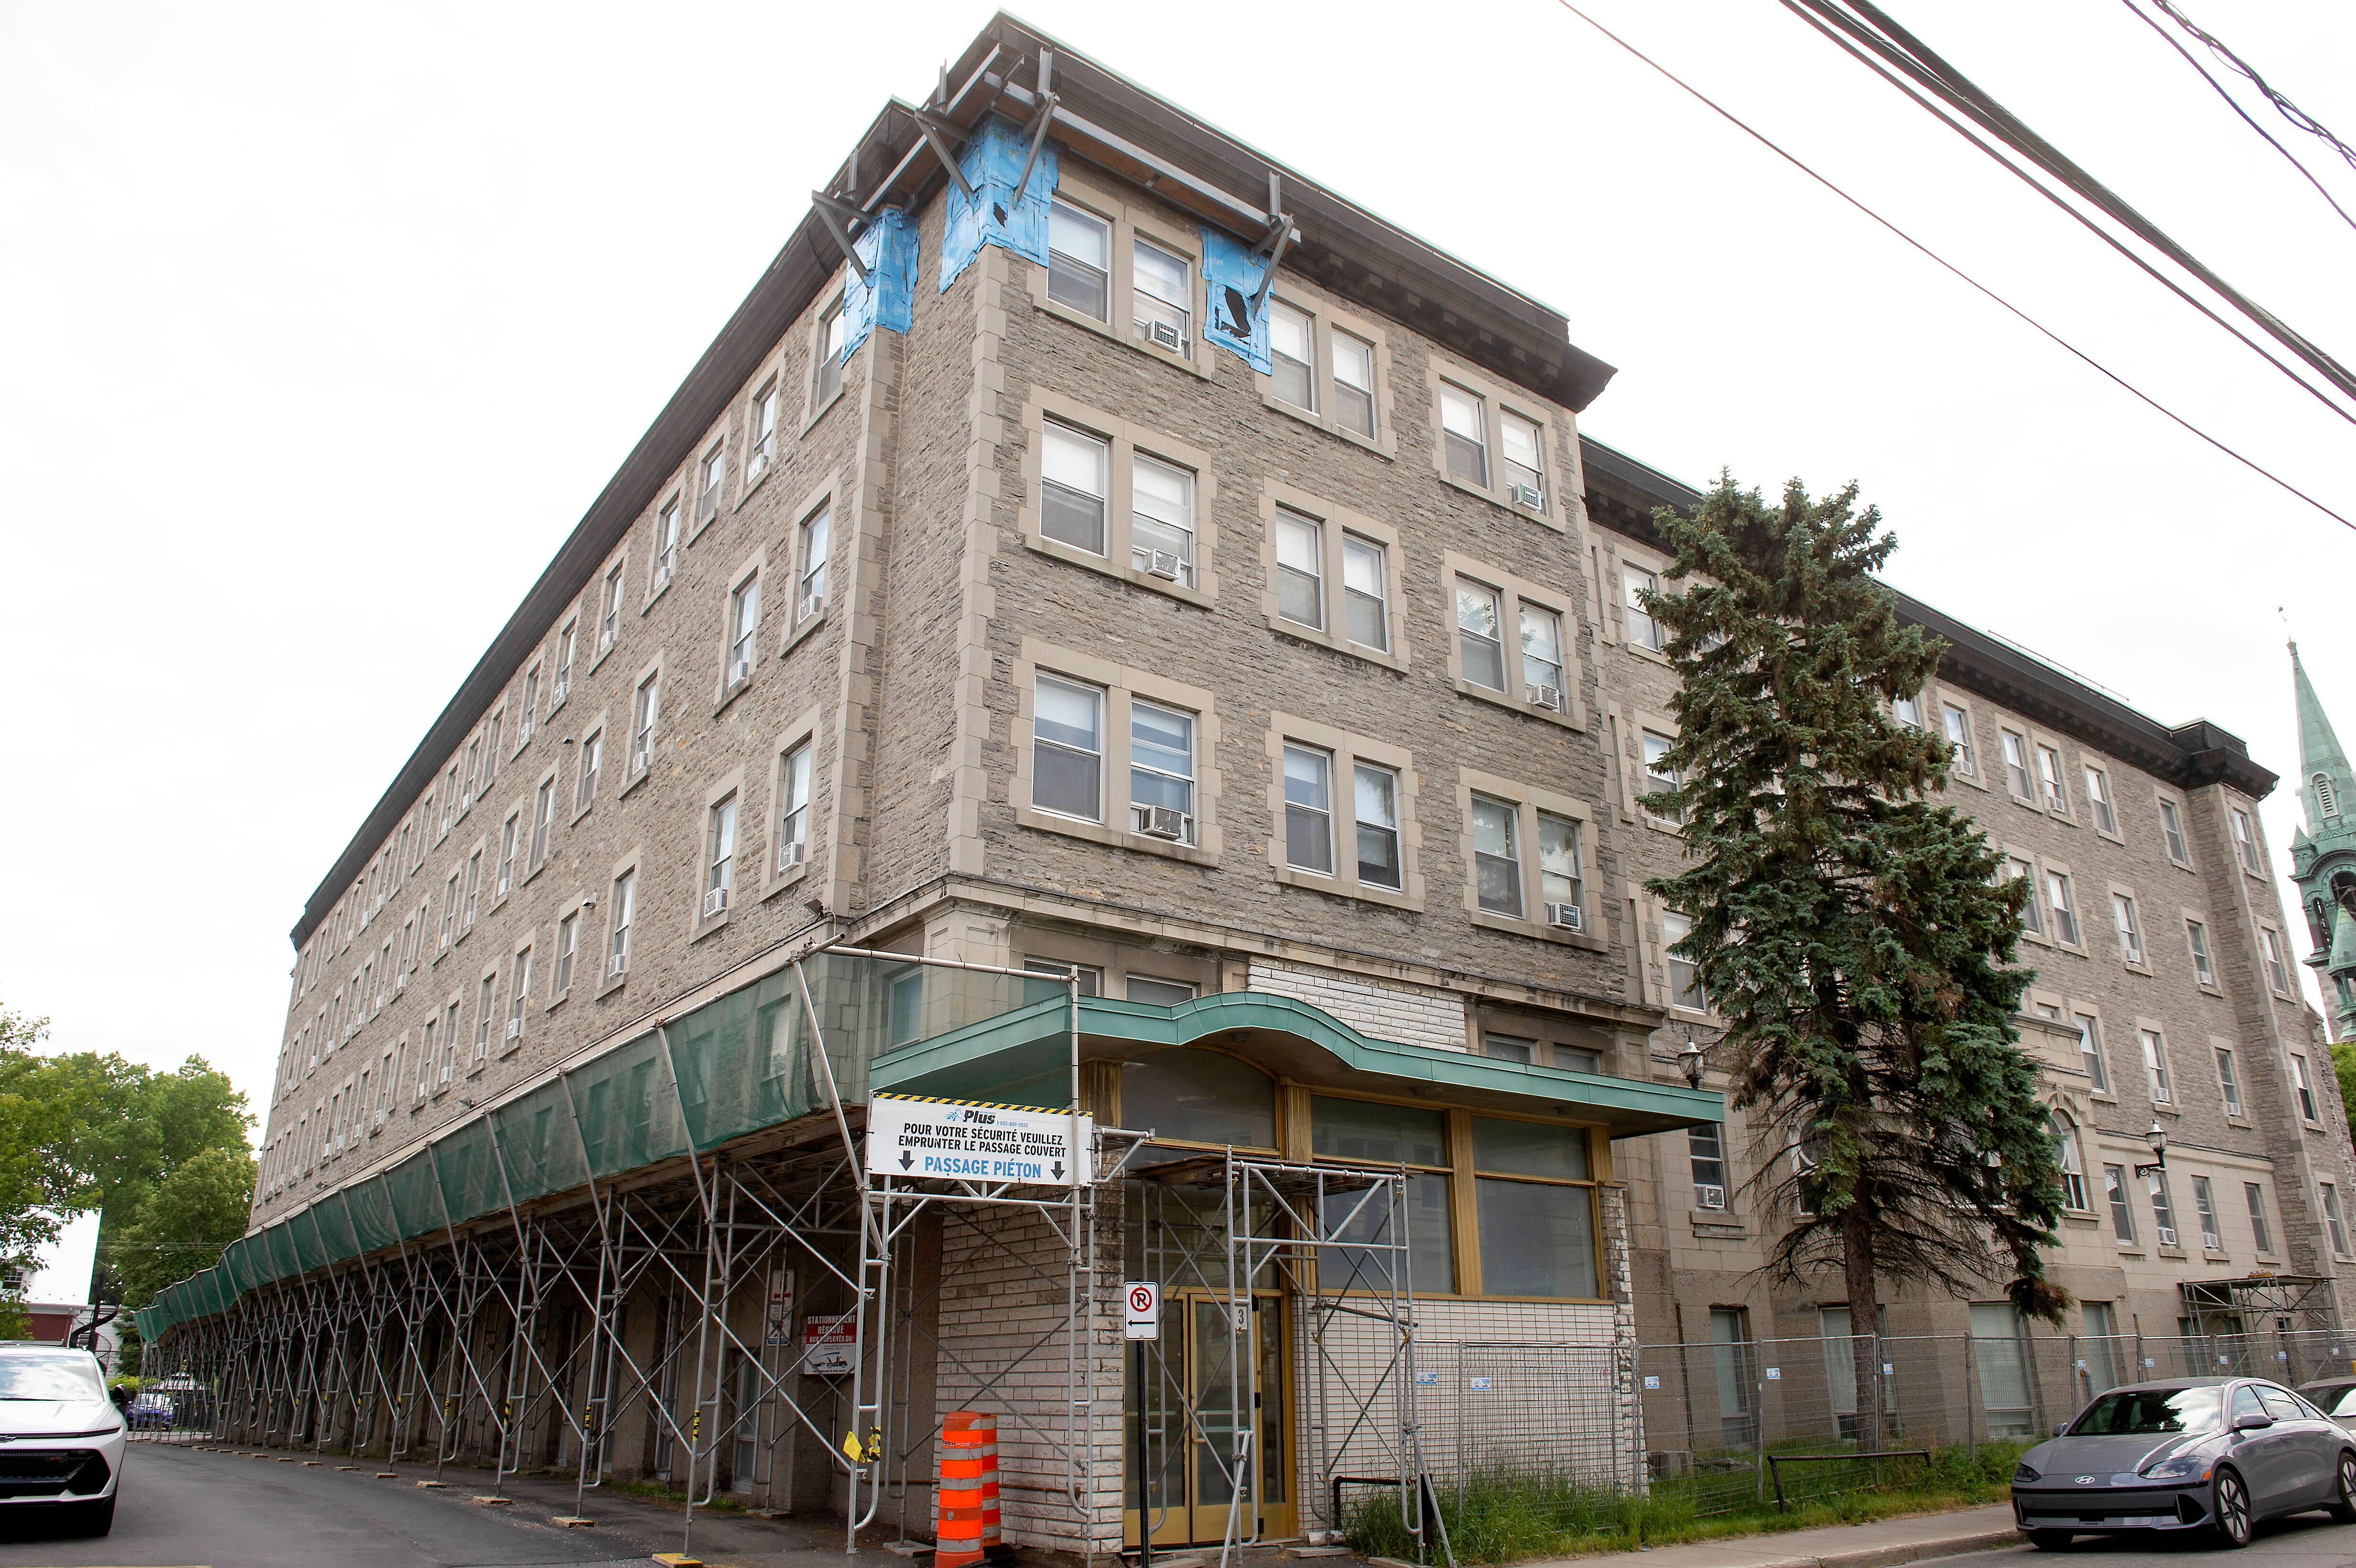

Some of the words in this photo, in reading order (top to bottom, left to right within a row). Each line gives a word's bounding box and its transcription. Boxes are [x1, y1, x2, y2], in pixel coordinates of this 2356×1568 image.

[963, 1110, 995, 1124] Plus
[904, 1123, 932, 1135] POUR
[936, 1125, 968, 1138] VOTRE
[971, 1126, 1017, 1142] SÉCURITÉ
[1020, 1132, 1063, 1145] VEUILLEZ
[898, 1135, 960, 1150] EMPRUNTER
[964, 1140, 976, 1151] LE
[979, 1141, 1022, 1154] PASSAGE
[1025, 1144, 1066, 1157] COUVERT
[925, 1156, 989, 1175] PASSAGE
[994, 1158, 1041, 1178] PIÉTON
[1238, 1309, 1244, 1324] 3
[820, 1334, 845, 1342] PLOYÉS
